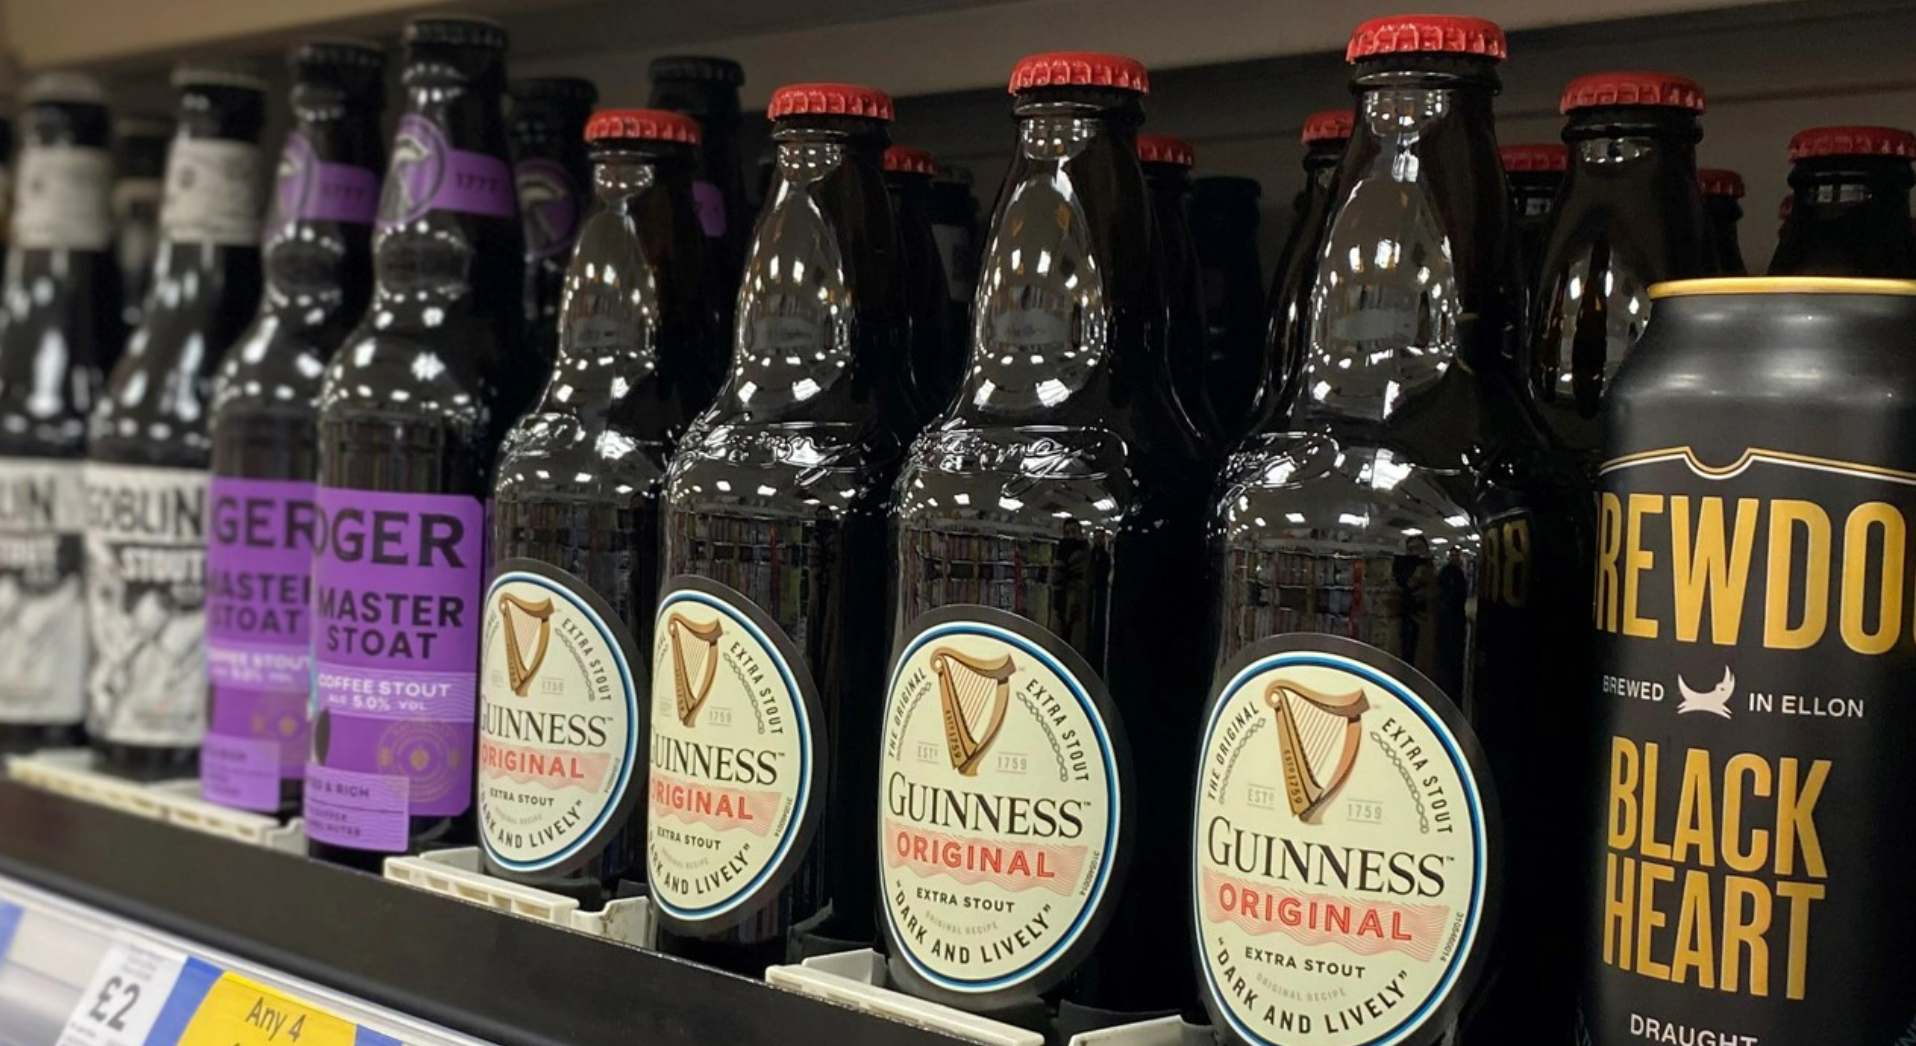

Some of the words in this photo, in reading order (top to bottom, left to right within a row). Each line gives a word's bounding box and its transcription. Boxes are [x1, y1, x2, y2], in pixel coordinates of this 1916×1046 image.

[1593, 490, 1916, 655] REWDO
[318, 586, 465, 629] MASTER
[327, 625, 438, 660] STOAT
[561, 618, 594, 665] EXTRA
[589, 662, 612, 702] STOUT
[318, 672, 376, 695] COFFEE
[379, 680, 452, 699] STOUT
[731, 641, 762, 685] EXTRA
[759, 686, 783, 736] STOUT
[1603, 674, 1664, 702] BREWED
[1749, 693, 1773, 713] IN
[1781, 695, 1864, 719] ELLON
[353, 697, 390, 712] 5.0%
[398, 701, 427, 712] VOL
[888, 730, 898, 758] THE
[895, 667, 927, 727] ORIGINAL
[948, 732, 962, 758] 1759
[1026, 679, 1066, 728] EXTRA
[1062, 730, 1089, 782] STOUT
[998, 756, 1027, 770] 1759
[1208, 768, 1220, 800] THE
[1215, 702, 1260, 766] ORIGINAL
[335, 784, 370, 797] RICH
[1287, 775, 1303, 804] 1759
[1382, 717, 1427, 771] EXTRA
[1423, 774, 1453, 835] STOUT
[490, 787, 515, 802] EXTRA
[518, 794, 555, 807] STOUT
[1347, 804, 1382, 820] 1759
[1608, 735, 1832, 878] BLACK
[498, 829, 523, 849] AND
[657, 826, 681, 842] EXTRA
[684, 834, 721, 850] STOUT
[897, 832, 1055, 879] ORIGINAL
[664, 872, 689, 895] AND
[917, 887, 958, 906] EXTRA
[964, 896, 1015, 913] STOUT
[1219, 882, 1412, 941] ORIGINAL
[1603, 852, 1826, 1000] HEART
[931, 938, 970, 964] AND
[1245, 946, 1297, 969] EXTRA
[1304, 958, 1366, 979] STOUT
[88, 975, 141, 1032] £2
[1307, 987, 1347, 1002] RECIPE
[245, 996, 286, 1041] Any
[290, 1014, 308, 1043] 4
[1263, 1005, 1312, 1034] AND
